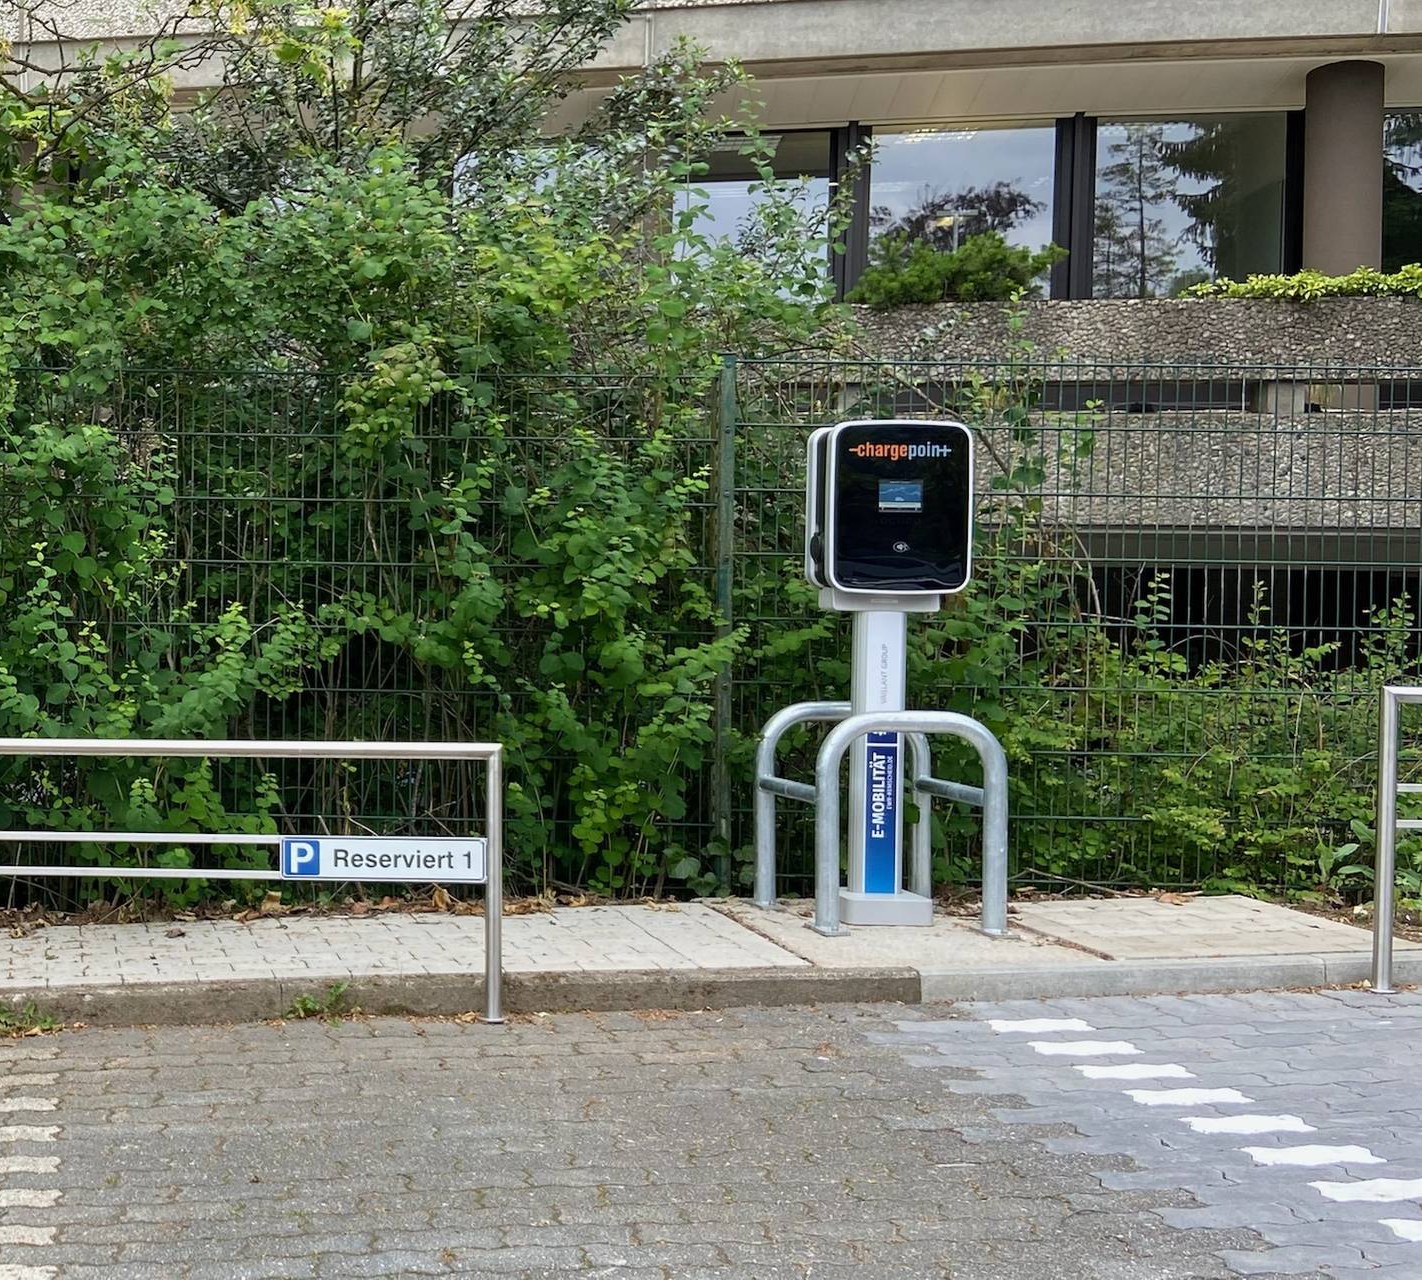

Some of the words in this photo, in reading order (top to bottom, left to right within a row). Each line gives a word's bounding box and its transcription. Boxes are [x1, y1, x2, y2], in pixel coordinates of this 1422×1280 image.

[881, 643, 889, 669] GROUP
[869, 752, 886, 839] E-MOBILITÄT
[290, 842, 314, 873] P
[333, 849, 454, 868] Reserviert
[462, 851, 472, 868] 1
